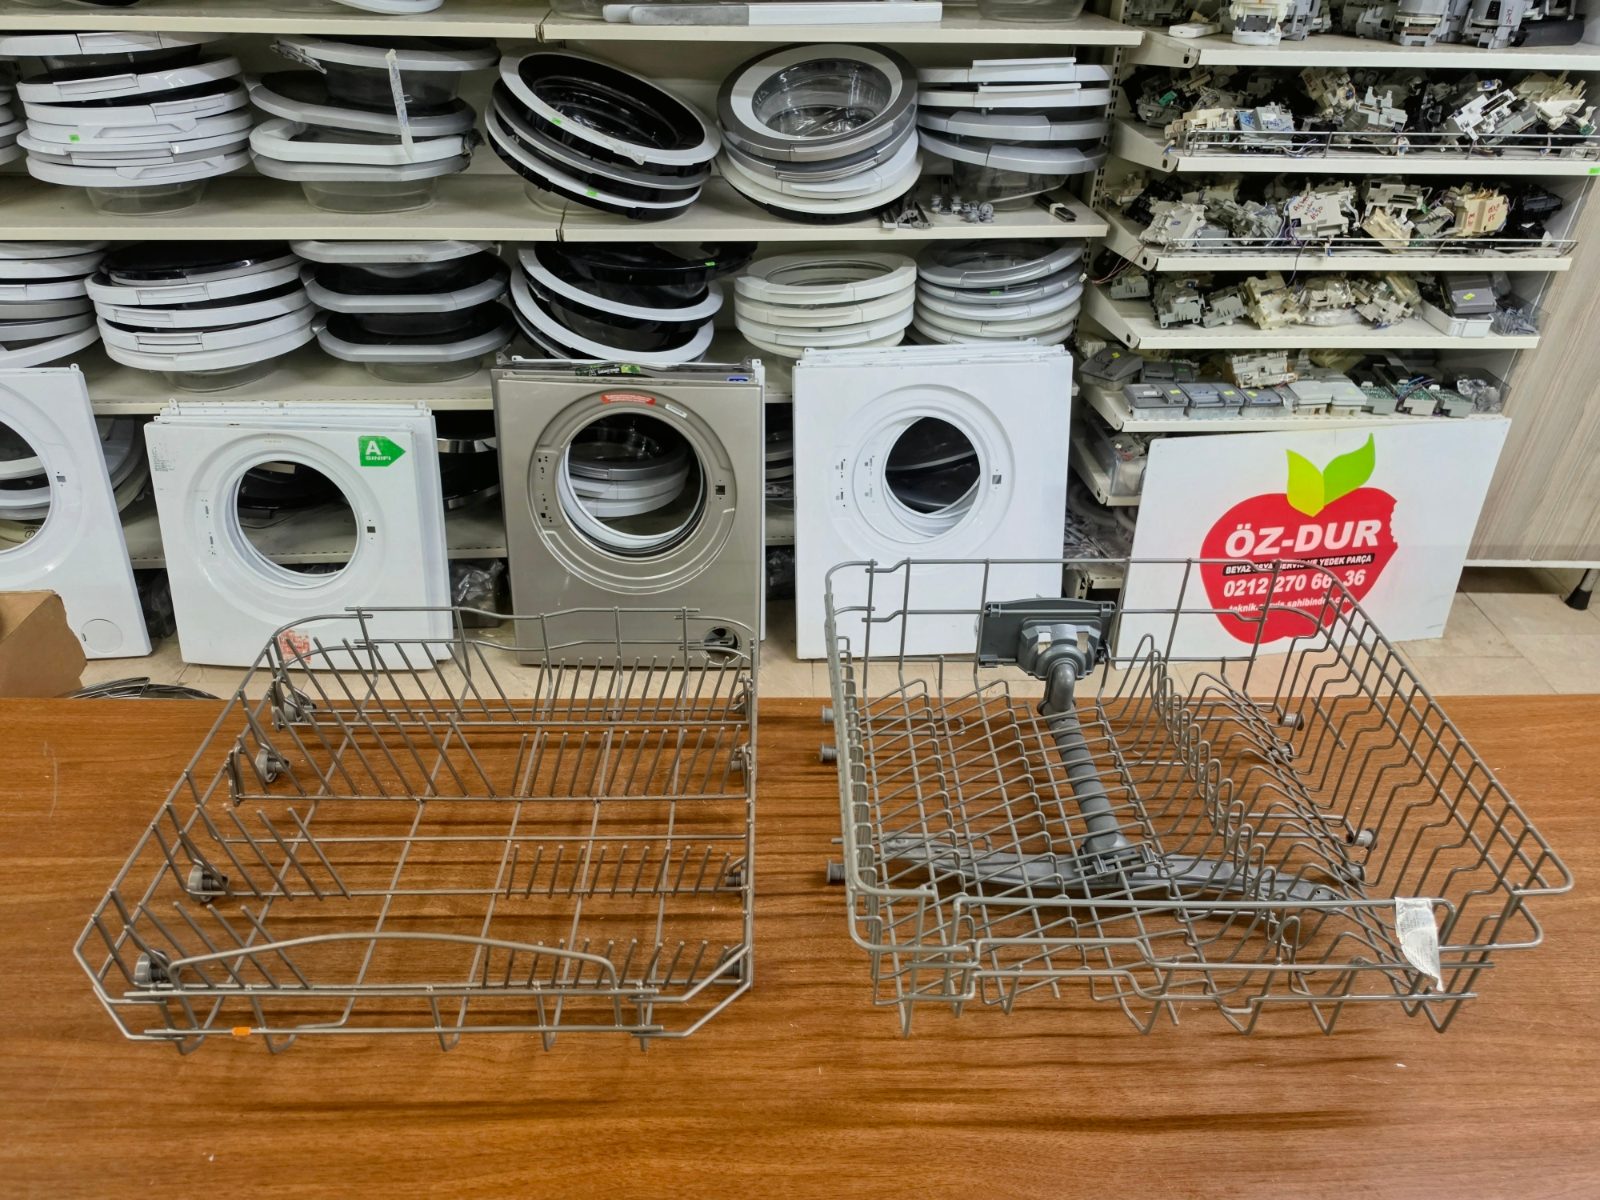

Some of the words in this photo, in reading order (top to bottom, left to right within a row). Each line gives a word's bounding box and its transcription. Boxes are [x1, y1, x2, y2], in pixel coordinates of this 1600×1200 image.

[365, 440, 382, 455] A
[1225, 519, 1382, 558] ÖZ-DUR
[1225, 565, 1252, 575] BEYAZ
[1319, 556, 1346, 567] YEDEK
[1347, 555, 1372, 564] PARÇA
[1224, 578, 1268, 597] 0212
[1273, 574, 1307, 593] 270
[1311, 573, 1332, 589] 66
[1343, 570, 1366, 587] 36
